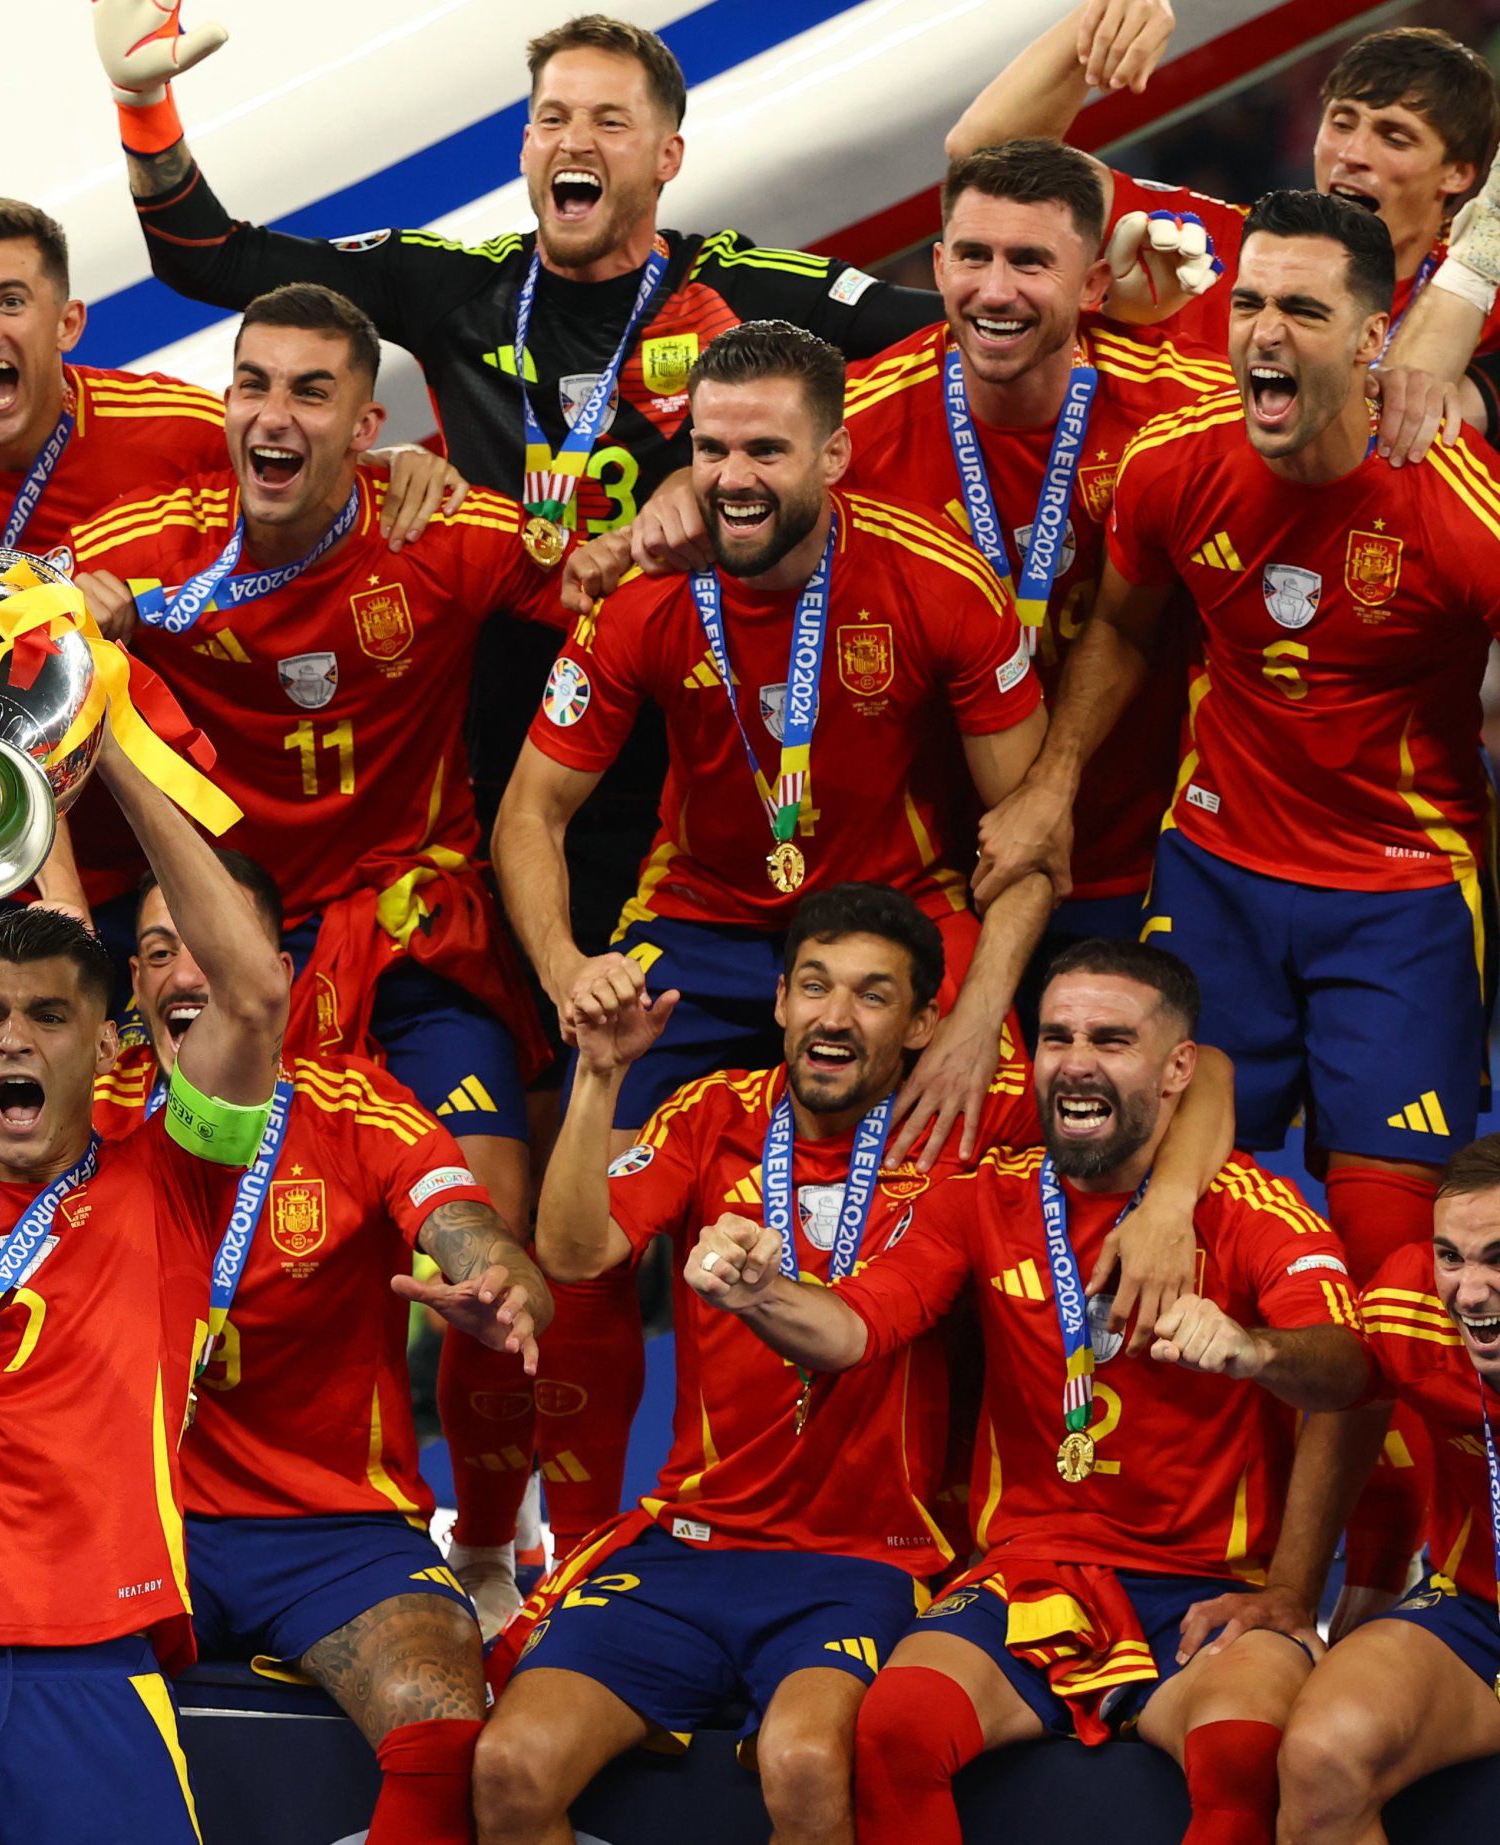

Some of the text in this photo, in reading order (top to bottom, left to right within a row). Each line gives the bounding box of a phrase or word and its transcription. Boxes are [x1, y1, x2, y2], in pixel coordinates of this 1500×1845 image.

[1262, 638, 1310, 700] 6
[284, 719, 355, 795] 11
[118, 1578, 163, 1599] HEAT.RDY
